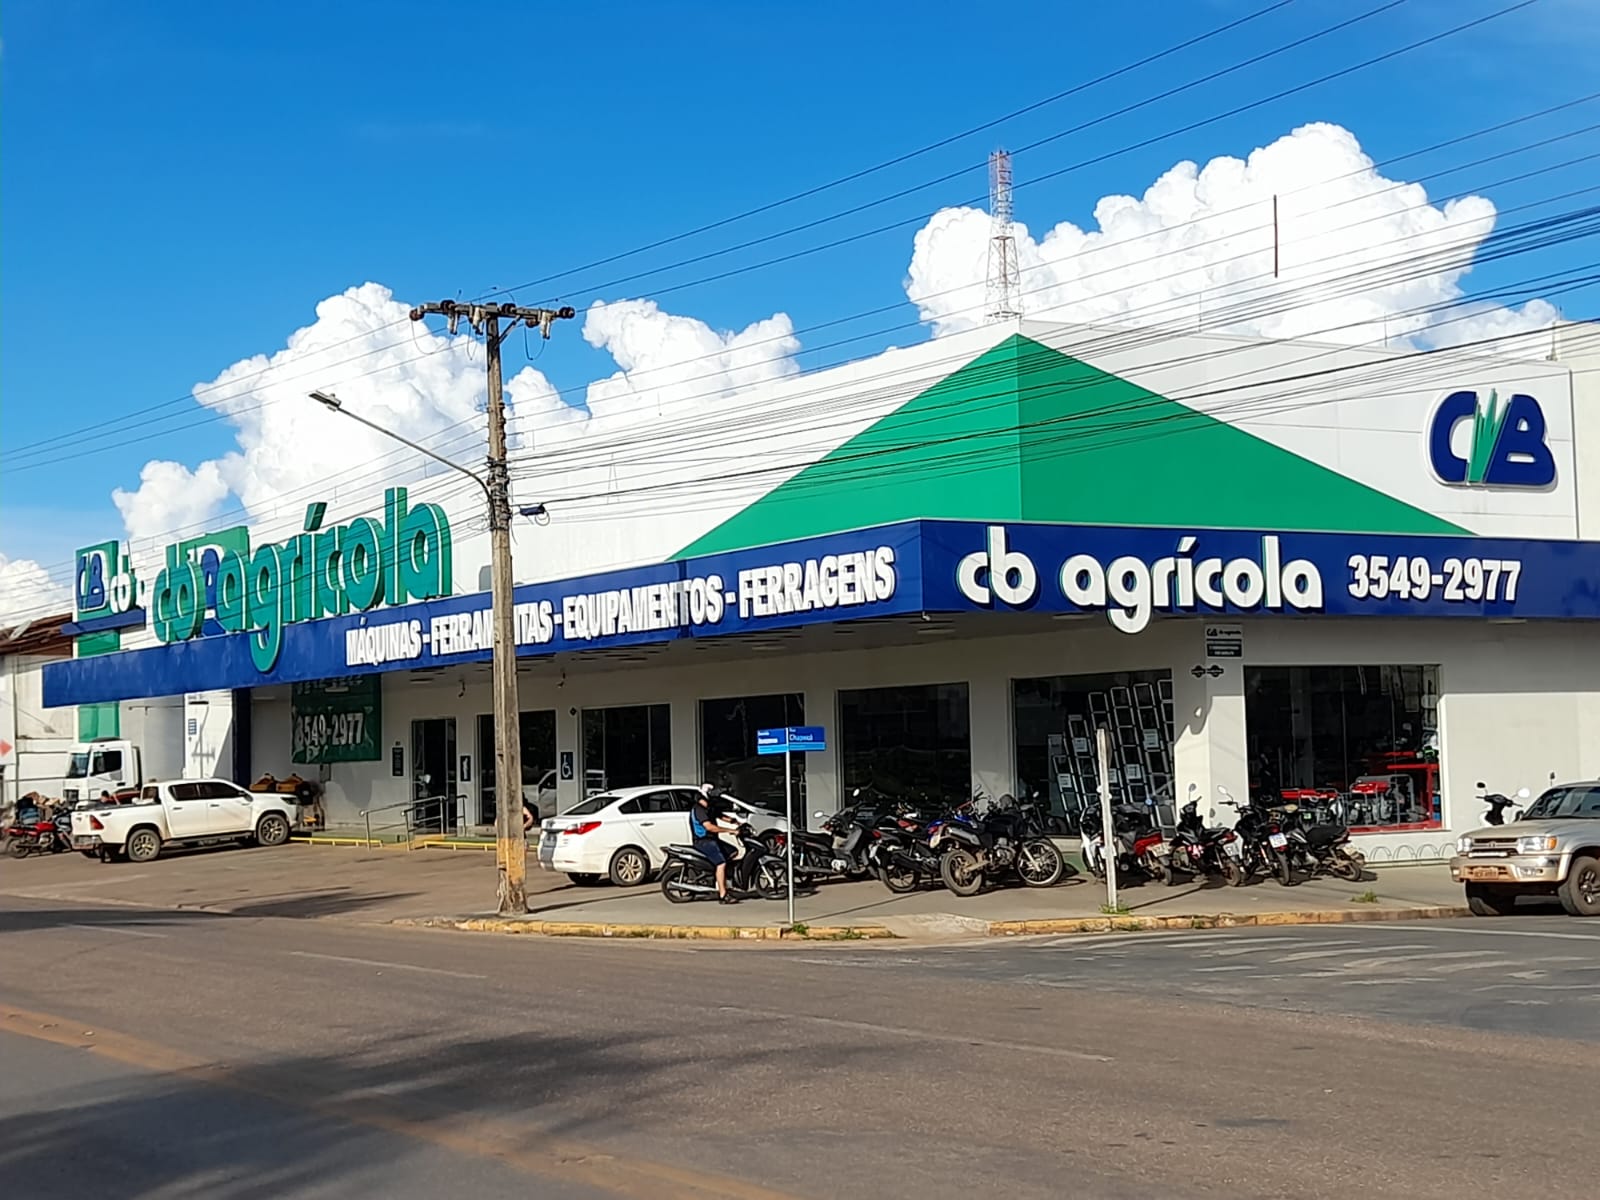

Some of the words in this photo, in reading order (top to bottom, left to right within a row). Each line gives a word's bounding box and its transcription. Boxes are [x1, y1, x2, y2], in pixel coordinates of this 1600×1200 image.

[1429, 390, 1556, 488] CB
[153, 543, 205, 643] cb
[216, 487, 452, 672] agrícola
[346, 616, 421, 666] MÁQUINAS
[563, 575, 724, 640] EQUIPAMENTOS
[739, 546, 895, 618] FERRAGENS
[957, 526, 1037, 605] cb
[1060, 536, 1323, 634] agrícola
[1348, 555, 1521, 601] 3549-2977
